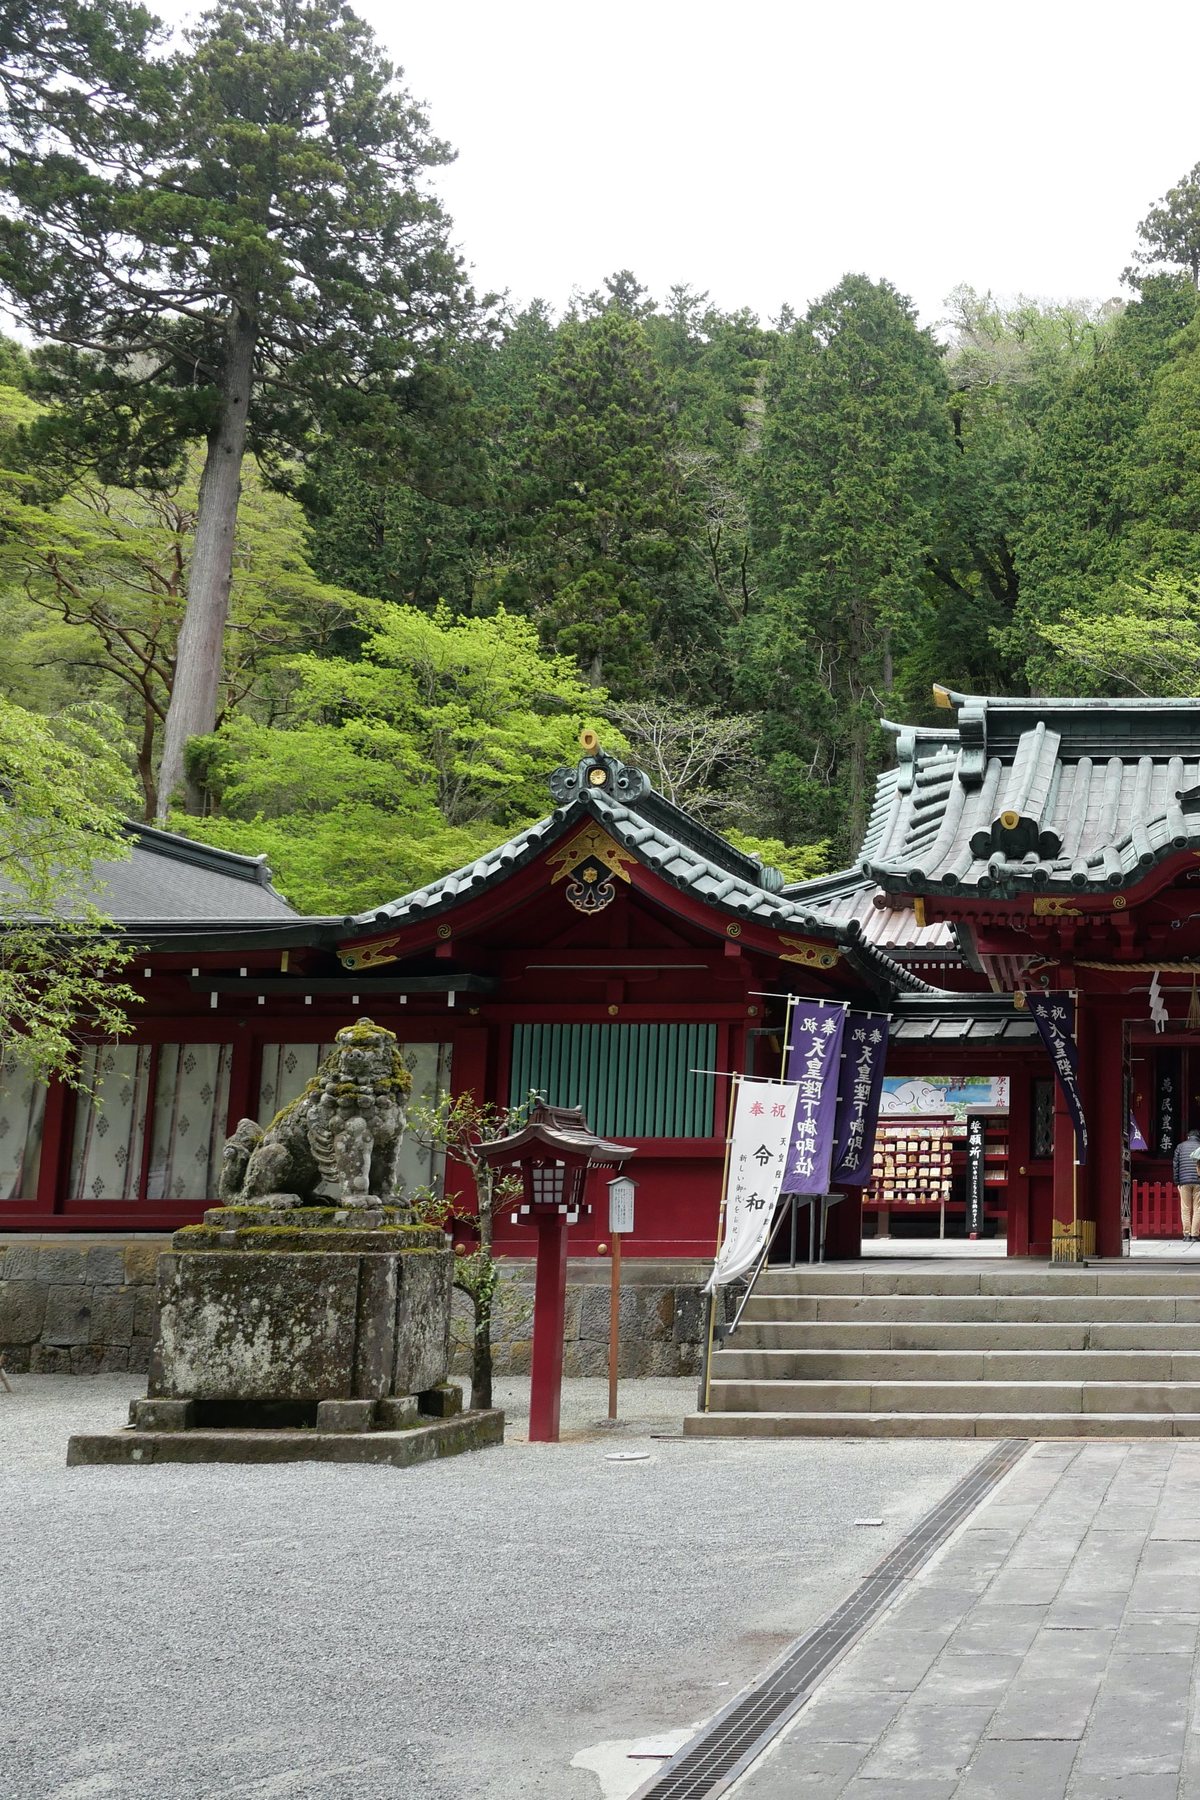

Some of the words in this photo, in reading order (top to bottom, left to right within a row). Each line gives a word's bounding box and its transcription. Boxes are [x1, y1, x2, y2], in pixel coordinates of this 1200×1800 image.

[749, 1100, 787, 1118] 奉祝
[968, 1120, 982, 1160] 誓願所
[744, 1144, 775, 1213] 令和
